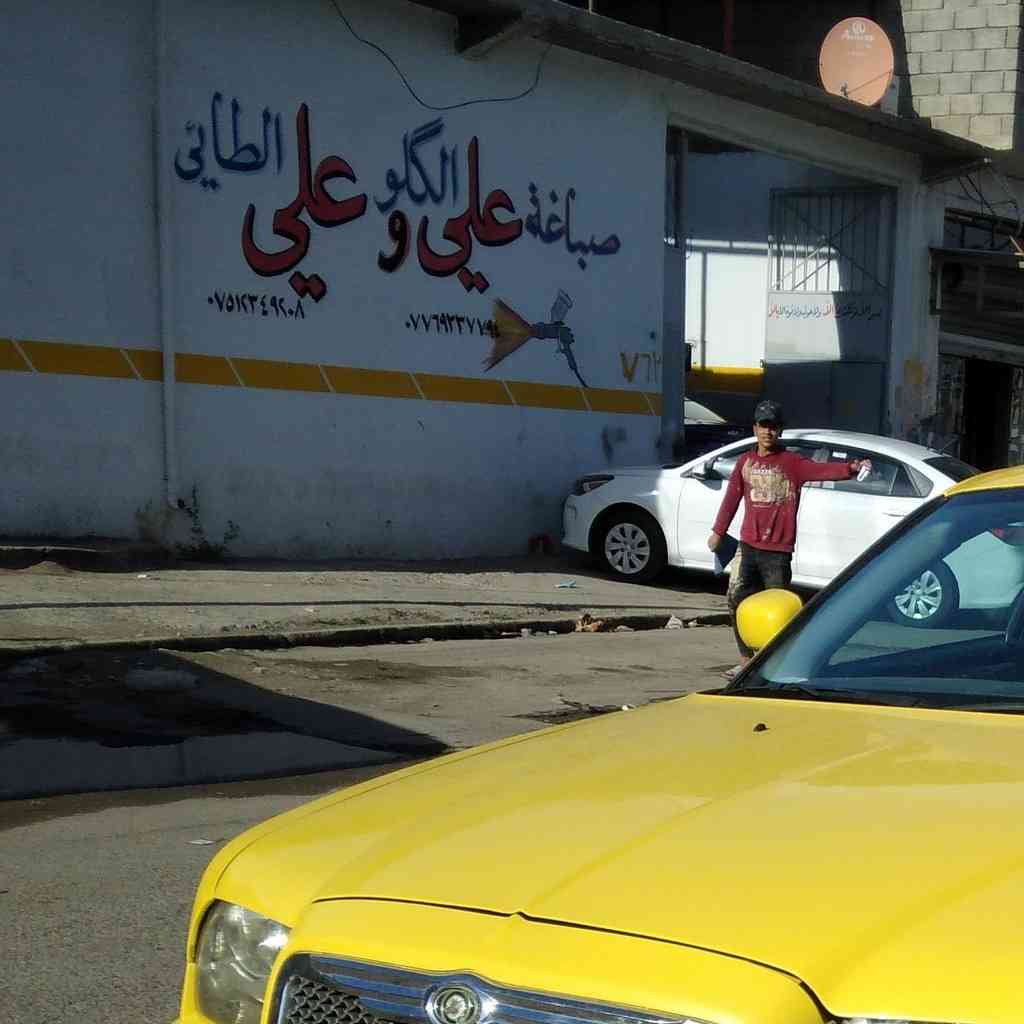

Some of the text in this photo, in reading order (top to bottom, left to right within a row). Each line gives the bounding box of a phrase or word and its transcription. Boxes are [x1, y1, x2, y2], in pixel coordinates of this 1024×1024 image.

[241, 102, 367, 303] علي
[377, 209, 411, 273] و
[417, 135, 523, 294] علي
[525, 181, 621, 271] صباغة
